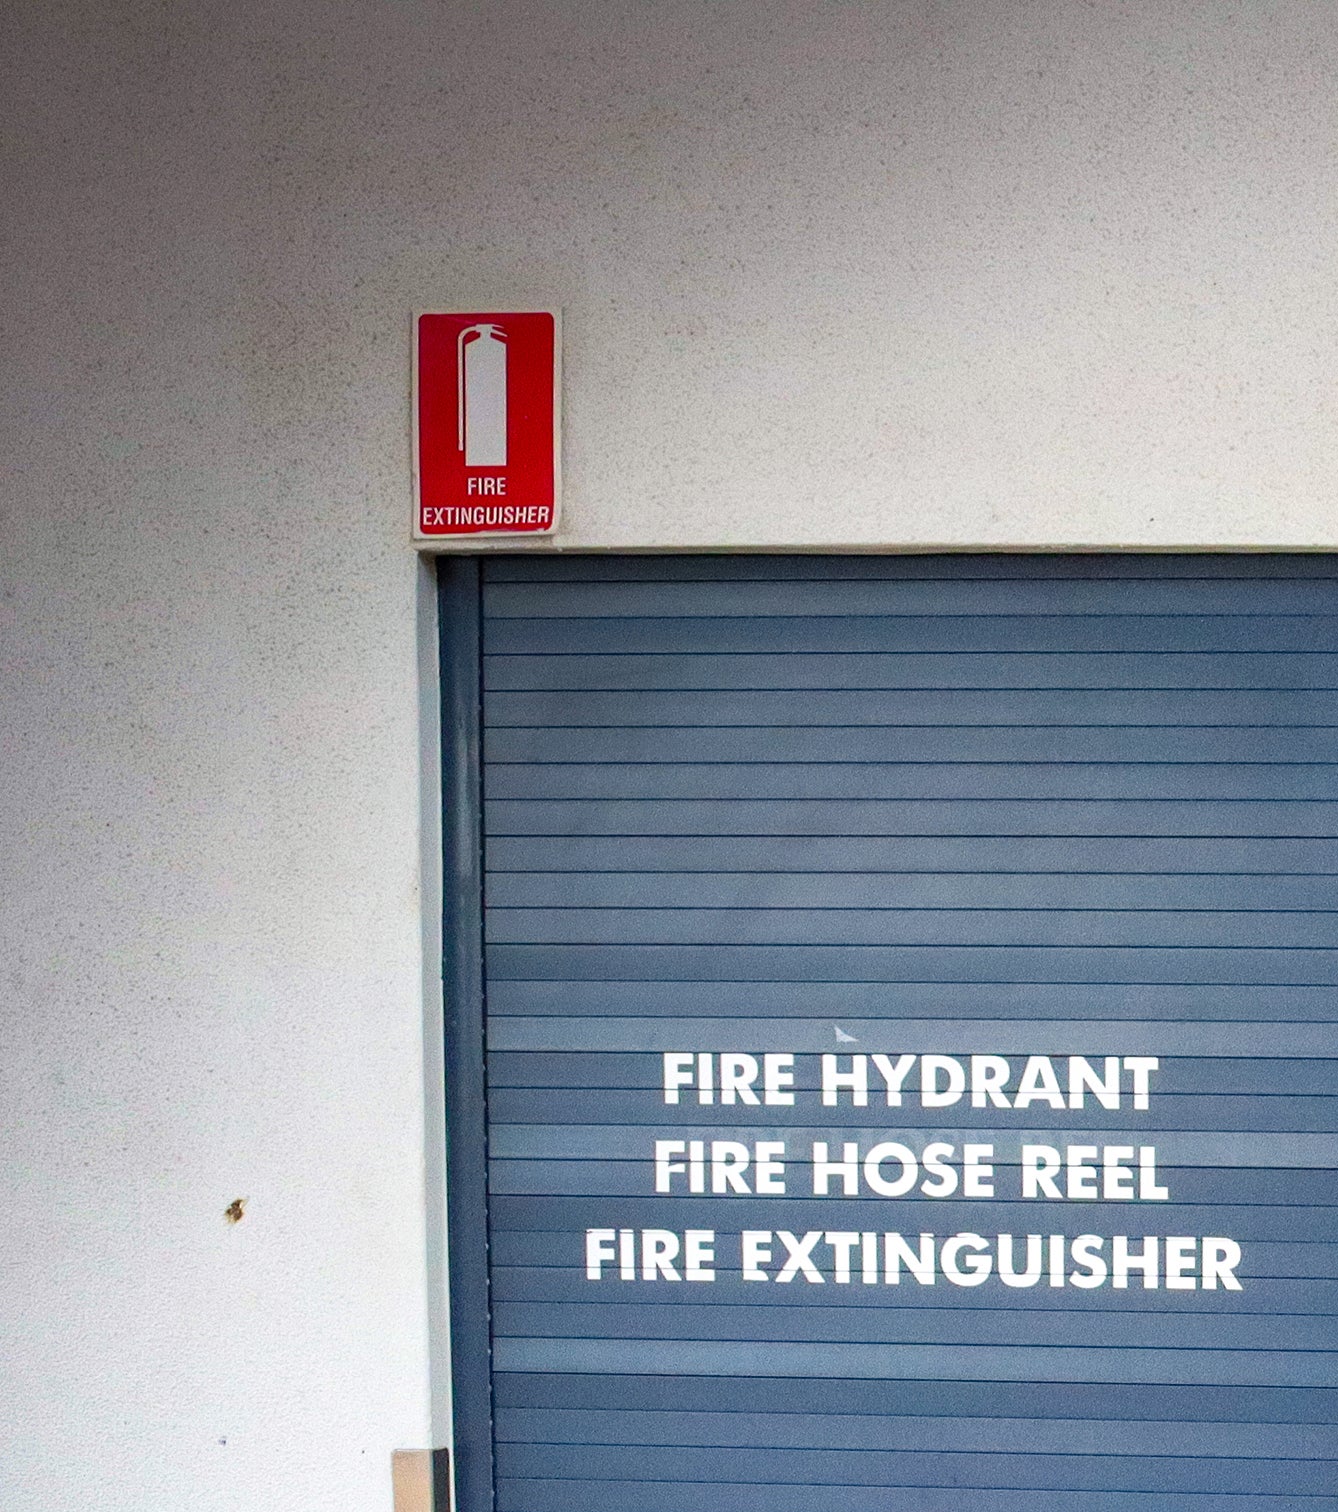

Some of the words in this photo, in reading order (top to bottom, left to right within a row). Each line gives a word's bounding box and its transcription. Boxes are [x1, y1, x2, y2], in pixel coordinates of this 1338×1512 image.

[467, 477, 507, 496] FIRE
[422, 505, 550, 526] EXTINGUISHER
[664, 1053, 795, 1106] FIRE
[822, 1055, 1159, 1110] HYDRANT
[655, 1140, 786, 1194] FIRE
[813, 1141, 995, 1198] HOSE
[1021, 1145, 1169, 1200] REEL
[585, 1228, 716, 1281] FIRE
[741, 1230, 1243, 1291] EXTINGUISHER
